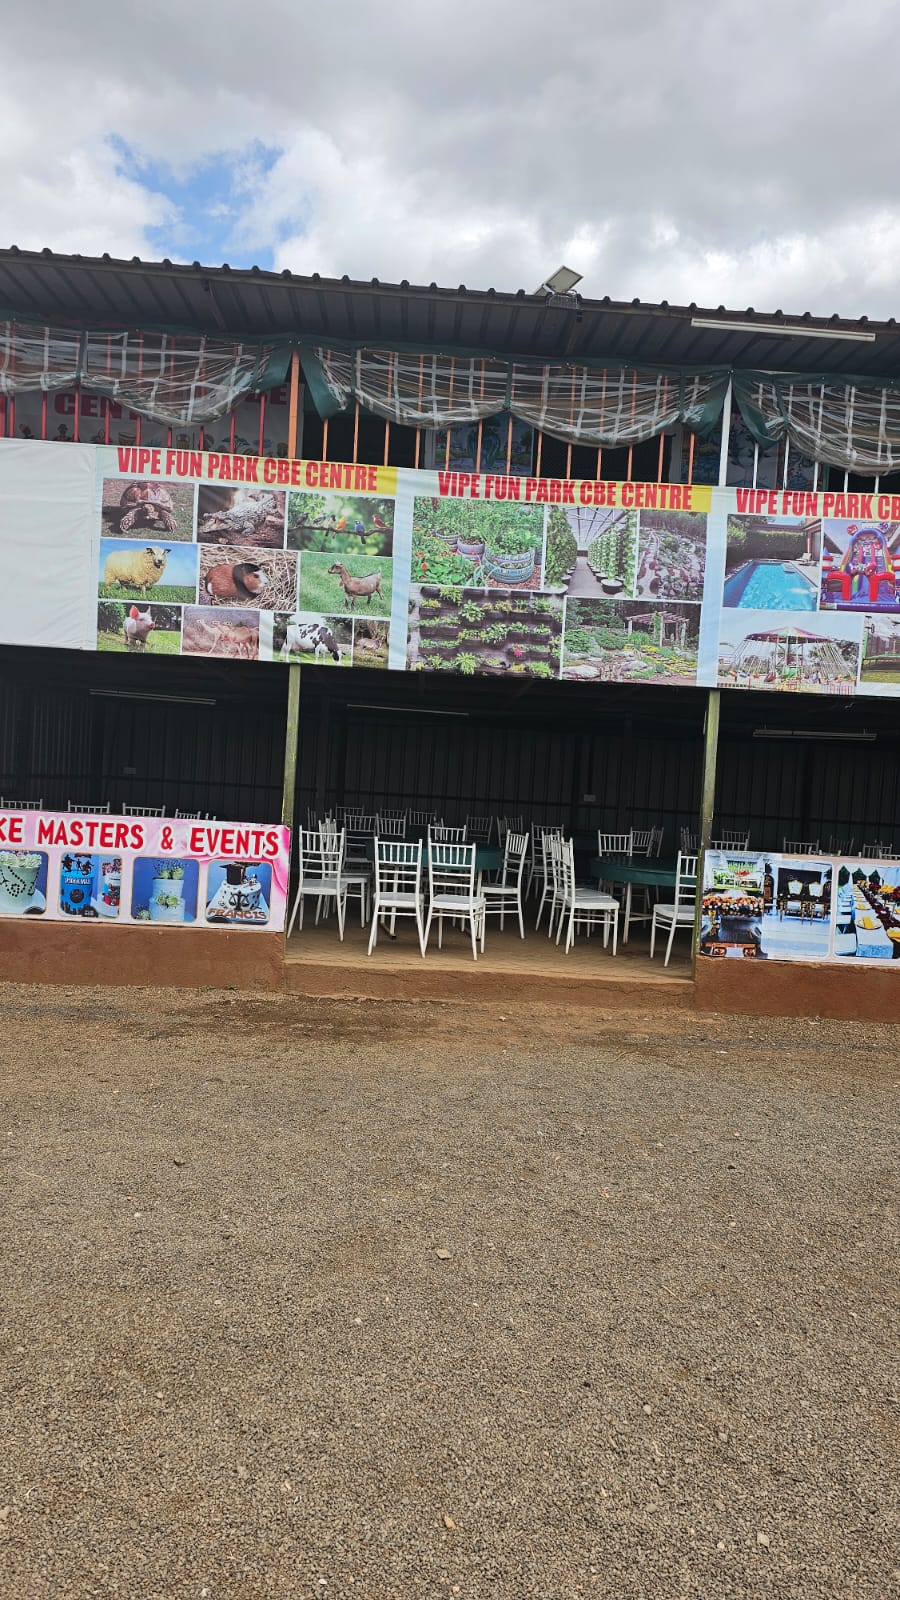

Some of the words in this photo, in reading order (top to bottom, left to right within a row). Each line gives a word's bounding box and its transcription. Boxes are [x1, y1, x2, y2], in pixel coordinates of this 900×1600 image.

[117, 447, 161, 474] VIPE
[165, 450, 203, 477] FUN
[207, 453, 259, 482] PARK
[263, 458, 301, 485] CBE
[305, 461, 378, 491] CENTRE
[438, 471, 480, 498] VIPE
[484, 475, 521, 500] FUN
[525, 477, 576, 504] PARK
[579, 480, 617, 507] CBE
[621, 482, 693, 511] CENTRE
[736, 488, 778, 515] VIPE
[782, 491, 818, 517] FUN
[823, 493, 873, 519] PARK
[38, 818, 144, 850] MASTERS
[161, 826, 174, 850] &
[189, 827, 279, 856] EVENTS
